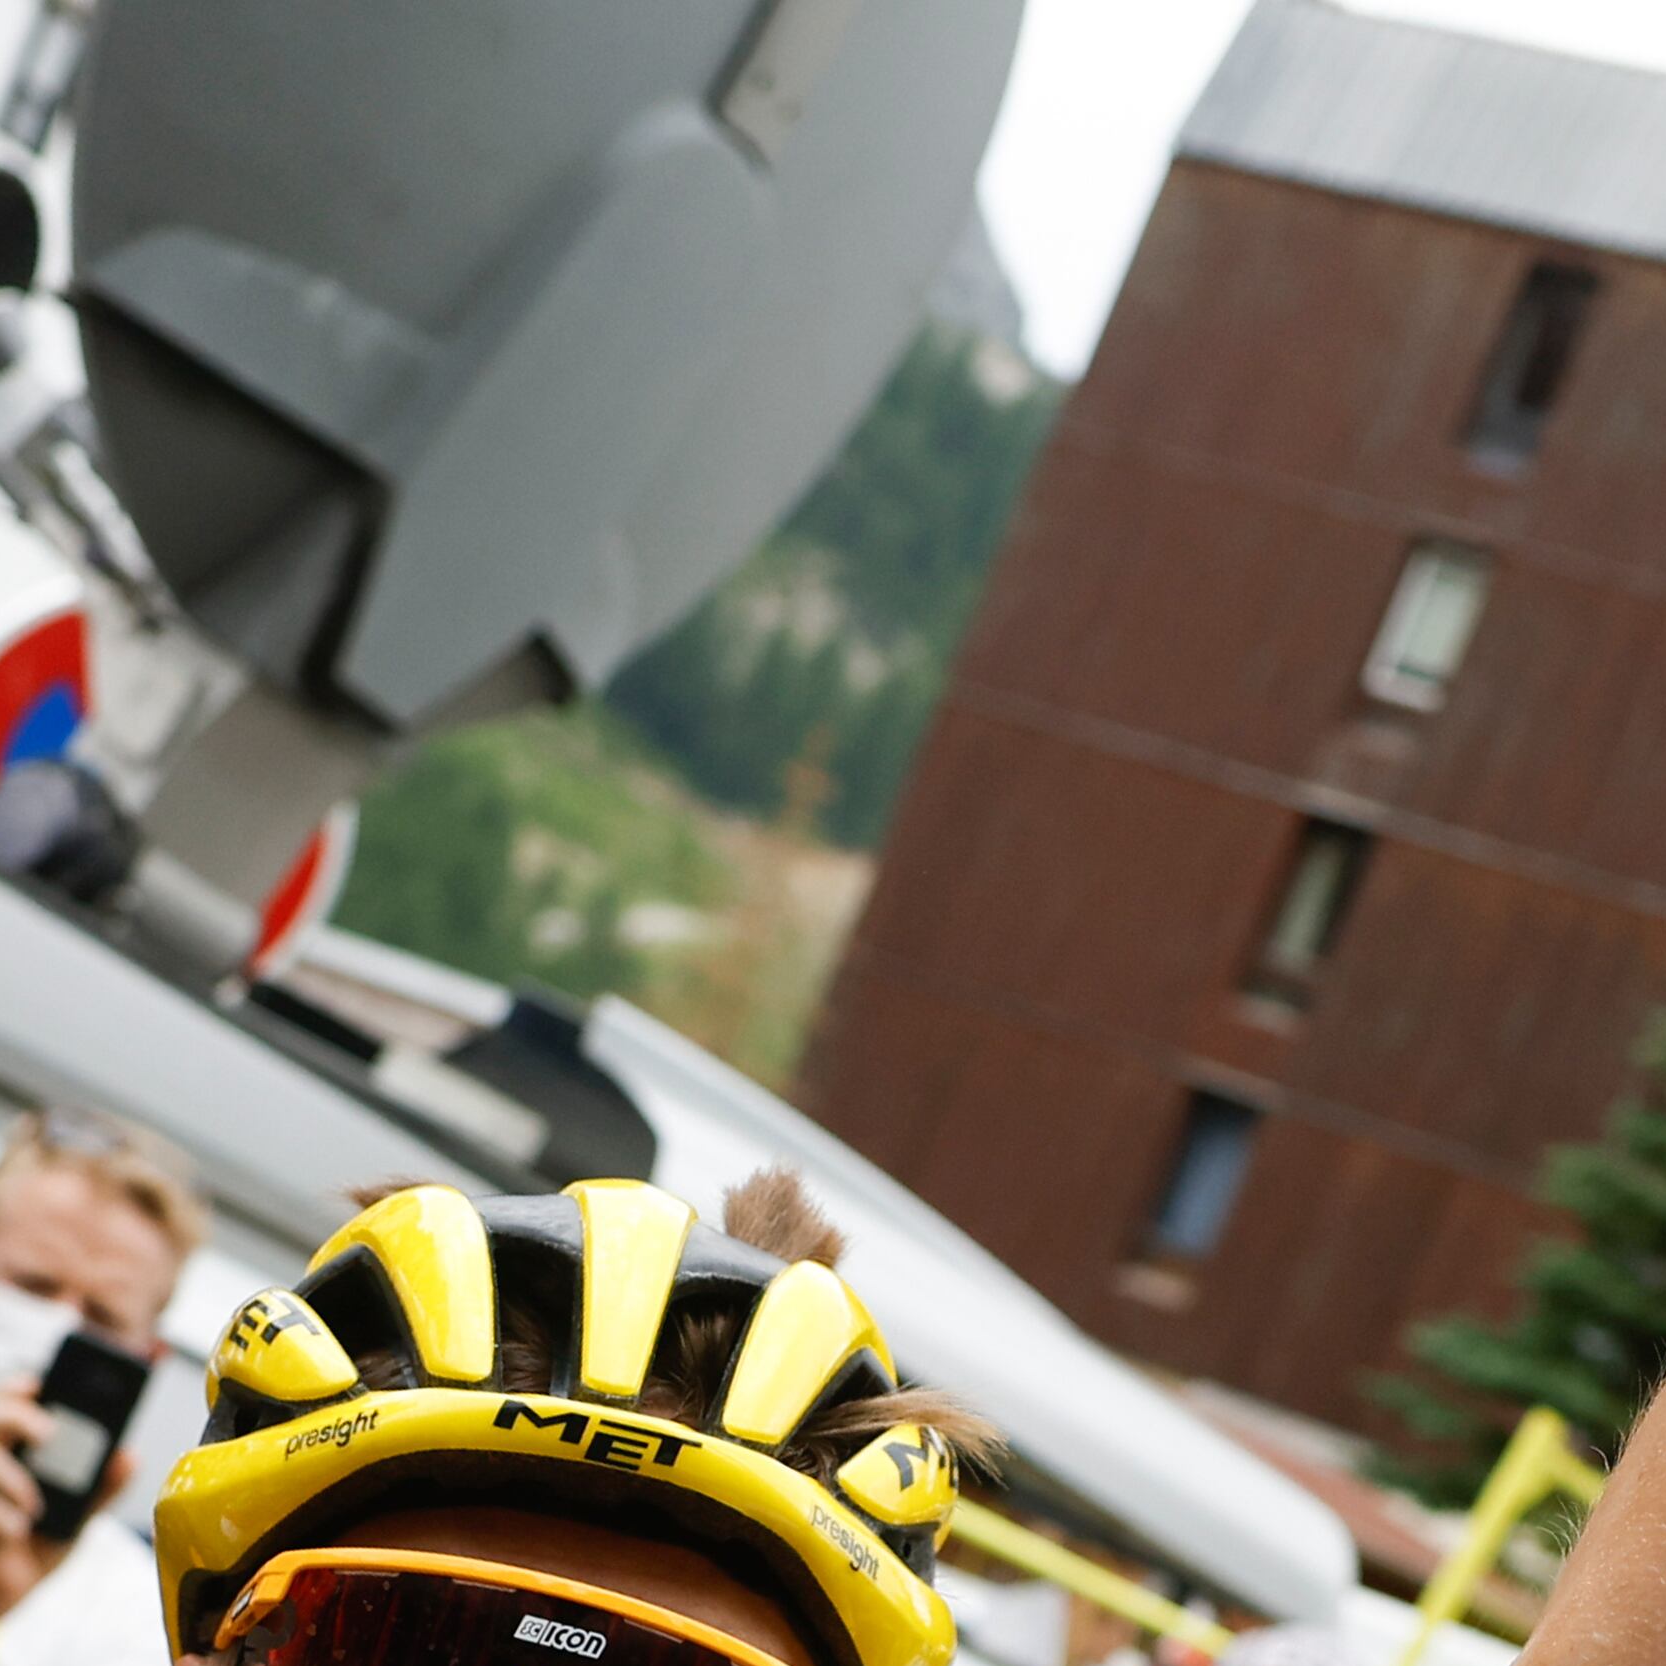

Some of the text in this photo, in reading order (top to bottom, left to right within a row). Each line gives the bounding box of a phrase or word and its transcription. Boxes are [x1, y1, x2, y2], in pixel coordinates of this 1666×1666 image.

[285, 1410, 379, 1461] presight
[492, 1399, 702, 1472] MET
[811, 1504, 880, 1580] presight
